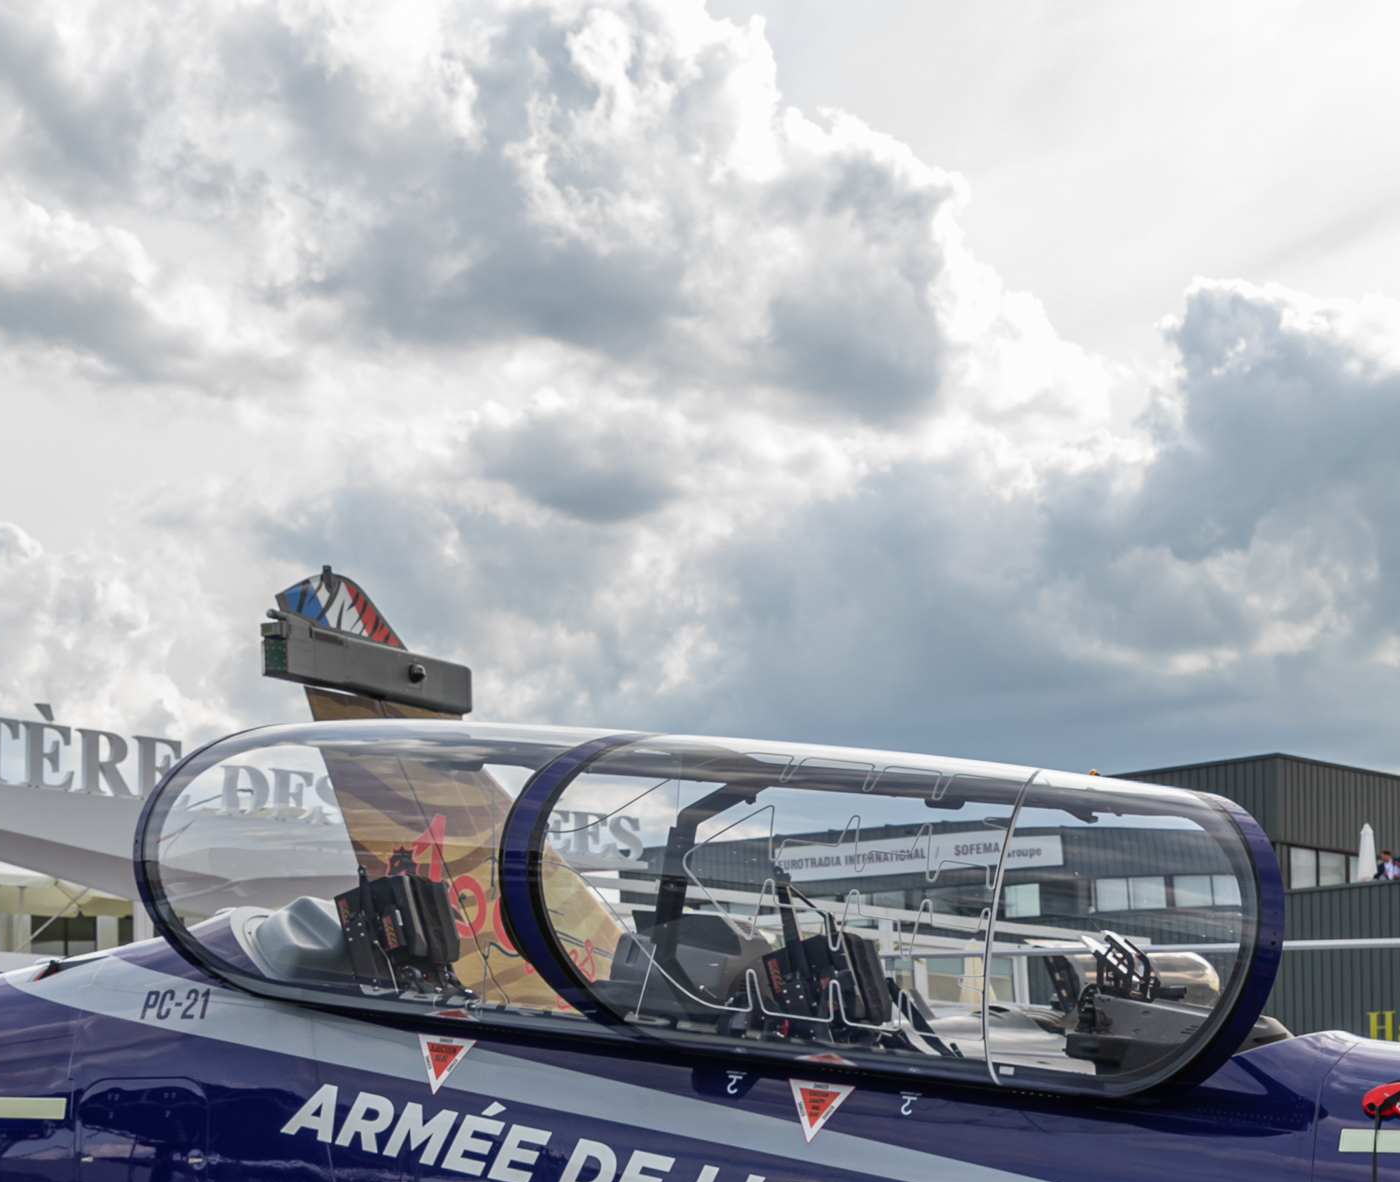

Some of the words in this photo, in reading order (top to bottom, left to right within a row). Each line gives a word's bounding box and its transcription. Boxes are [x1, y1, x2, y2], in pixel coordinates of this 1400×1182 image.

[845, 848, 926, 866] INTERNATIONAL
[954, 842, 1001, 857] SOFEMA
[140, 988, 211, 1020] PC-21
